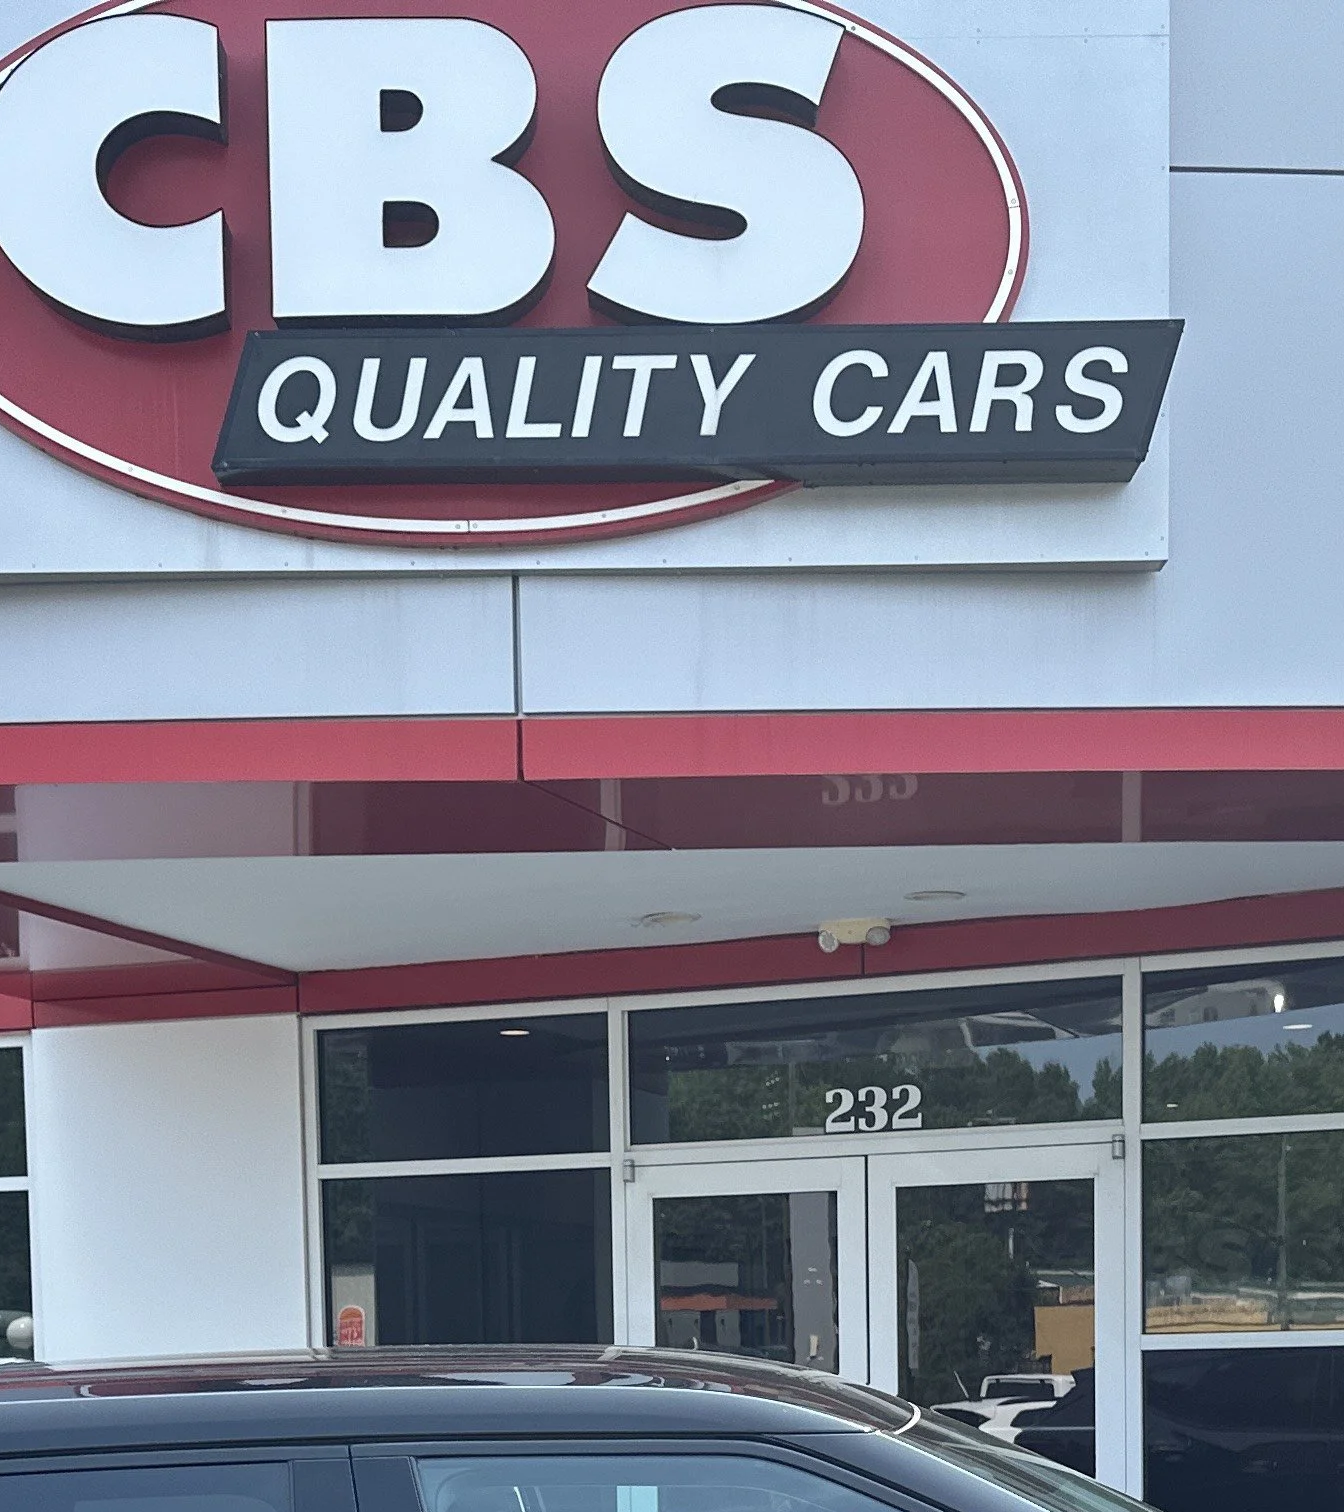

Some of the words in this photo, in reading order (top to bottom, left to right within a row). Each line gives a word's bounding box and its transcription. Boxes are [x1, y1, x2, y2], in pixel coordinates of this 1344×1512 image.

[255, 353, 756, 444] QUALITY
[812, 346, 1130, 437] CARS
[825, 1084, 923, 1133] 232
